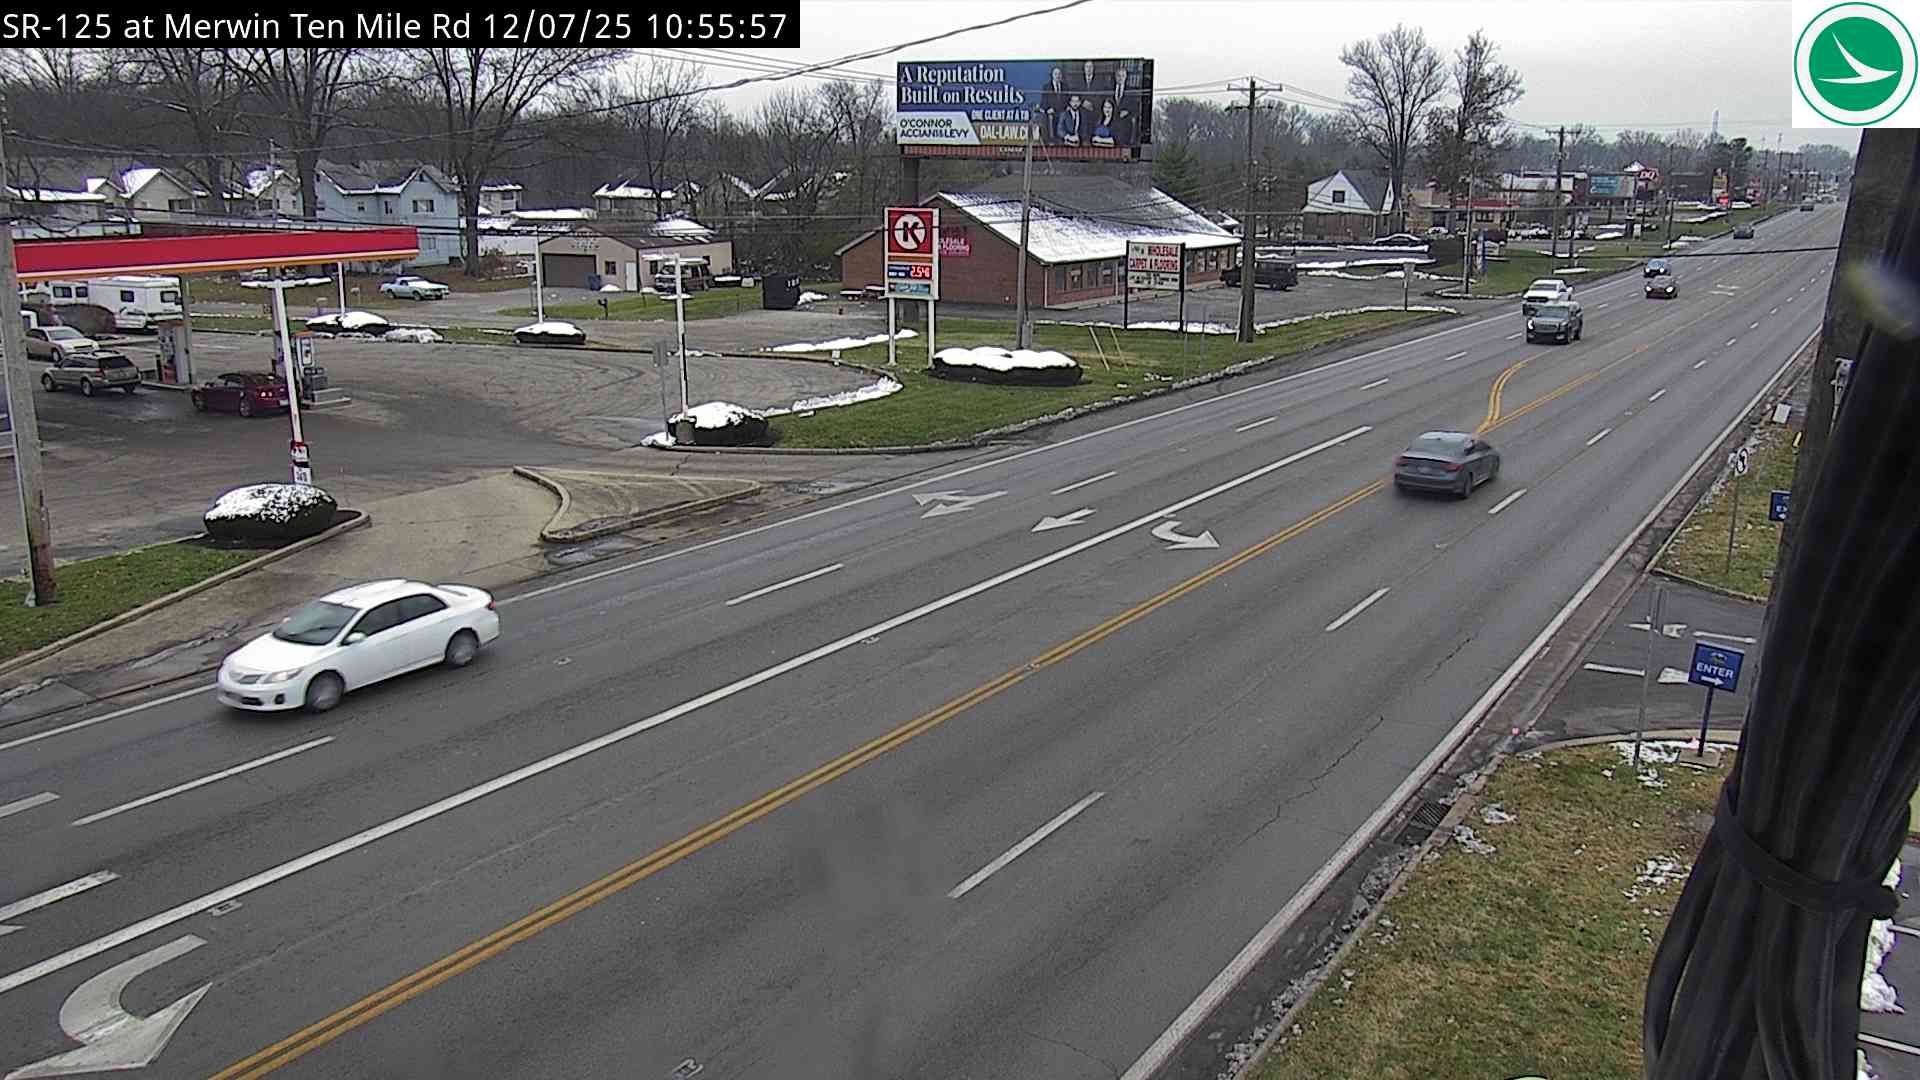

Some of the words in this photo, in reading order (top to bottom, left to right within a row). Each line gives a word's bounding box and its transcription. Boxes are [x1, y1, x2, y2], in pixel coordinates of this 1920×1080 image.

[900, 66, 913, 83] A
[917, 64, 1004, 86] Reputation
[901, 86, 939, 104] Built
[942, 90, 960, 104] on
[961, 85, 1025, 104] Results
[900, 118, 953, 129] O'CONNOR
[944, 128, 969, 139] LEVY
[1639, 170, 1656, 180] DQ
[902, 221, 921, 250] K
[1696, 662, 1734, 679] ENTER
